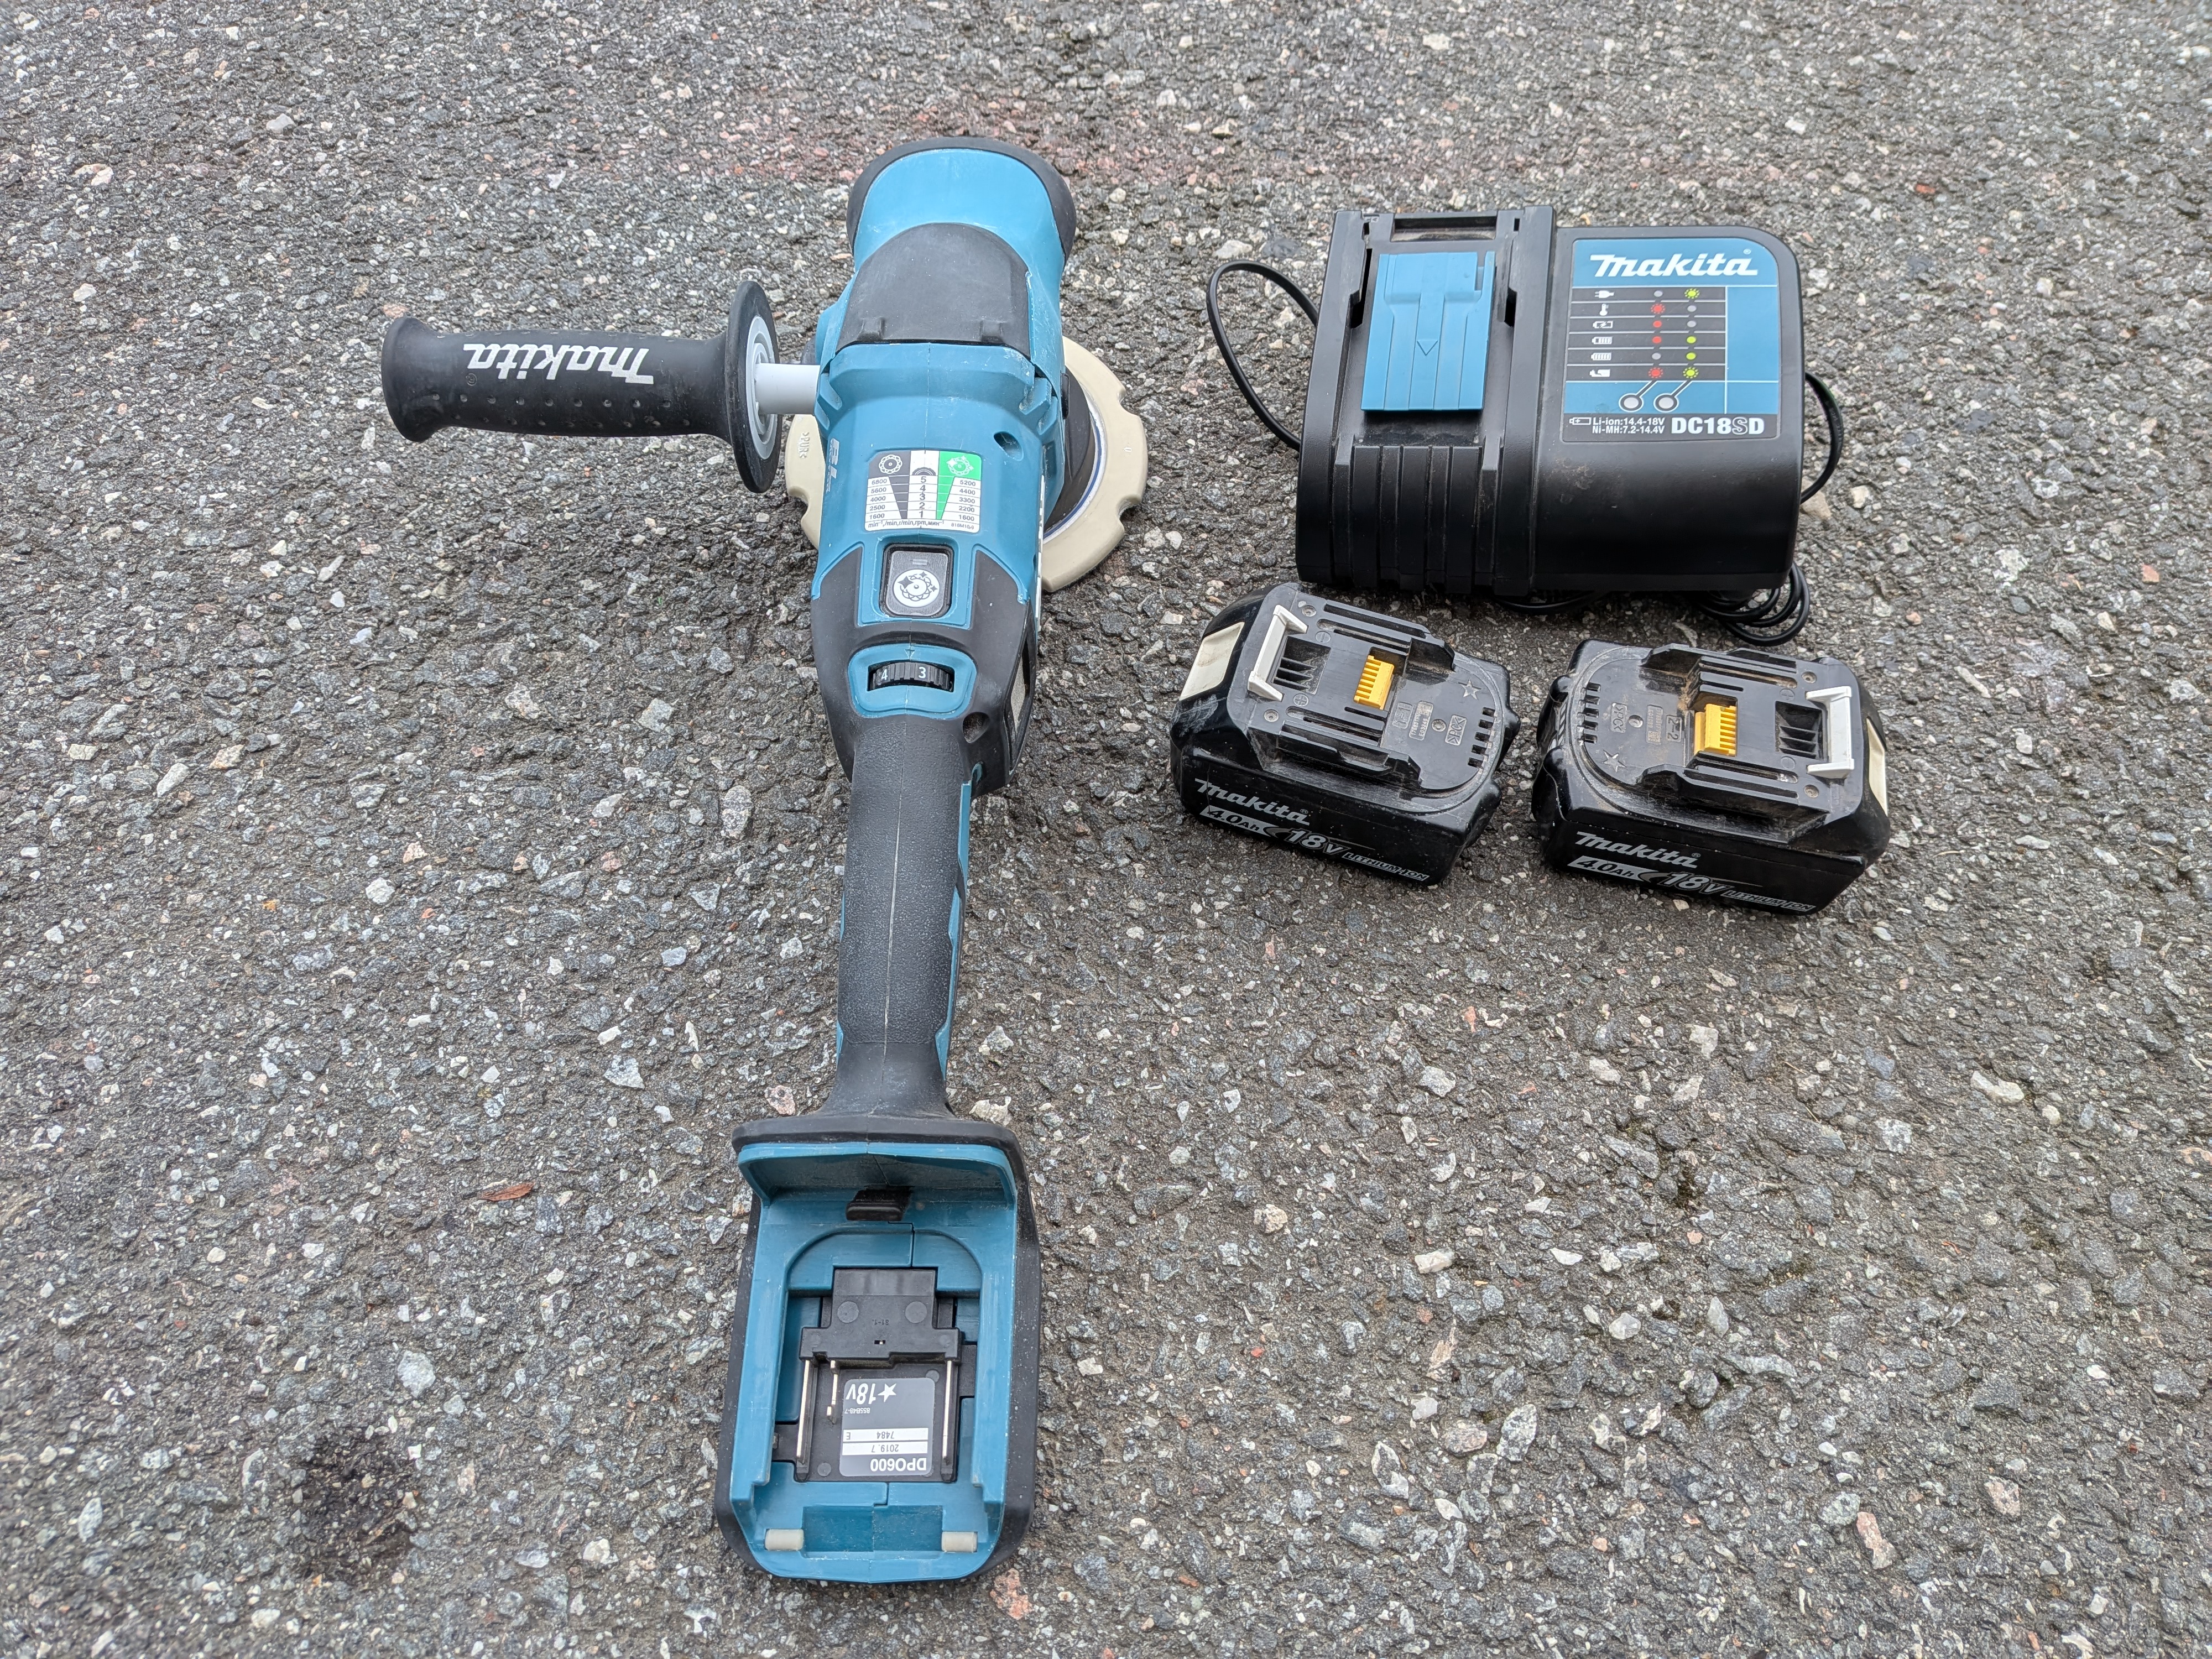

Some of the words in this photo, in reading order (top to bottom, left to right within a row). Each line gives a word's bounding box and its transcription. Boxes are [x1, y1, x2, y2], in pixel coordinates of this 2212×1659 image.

[1671, 416, 1765, 435] DC18SD
[881, 669, 888, 680] 4
[919, 666, 926, 679] 3
[870, 1458, 926, 1472] DPO600
